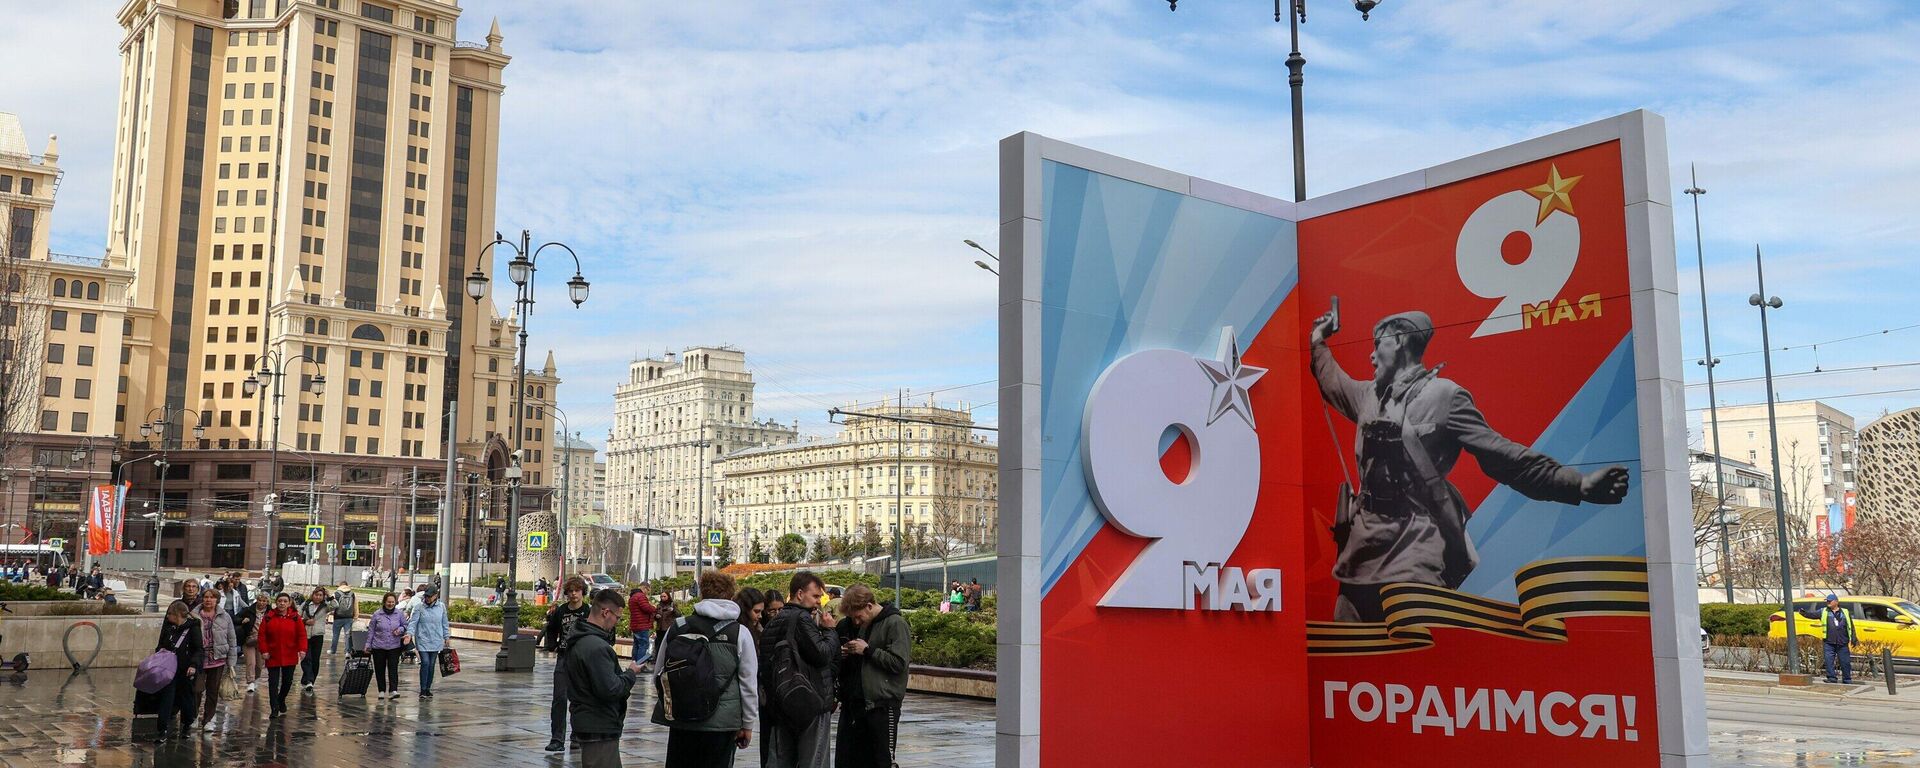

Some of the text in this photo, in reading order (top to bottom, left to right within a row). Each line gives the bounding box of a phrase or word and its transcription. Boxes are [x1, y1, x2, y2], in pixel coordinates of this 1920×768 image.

[1456, 189, 1580, 339] 9
[1522, 292, 1602, 329] МАЯ
[1080, 349, 1261, 609] 9
[1183, 561, 1282, 612] МАЯ
[1324, 680, 1638, 742] ГОРДИМСЯ!
